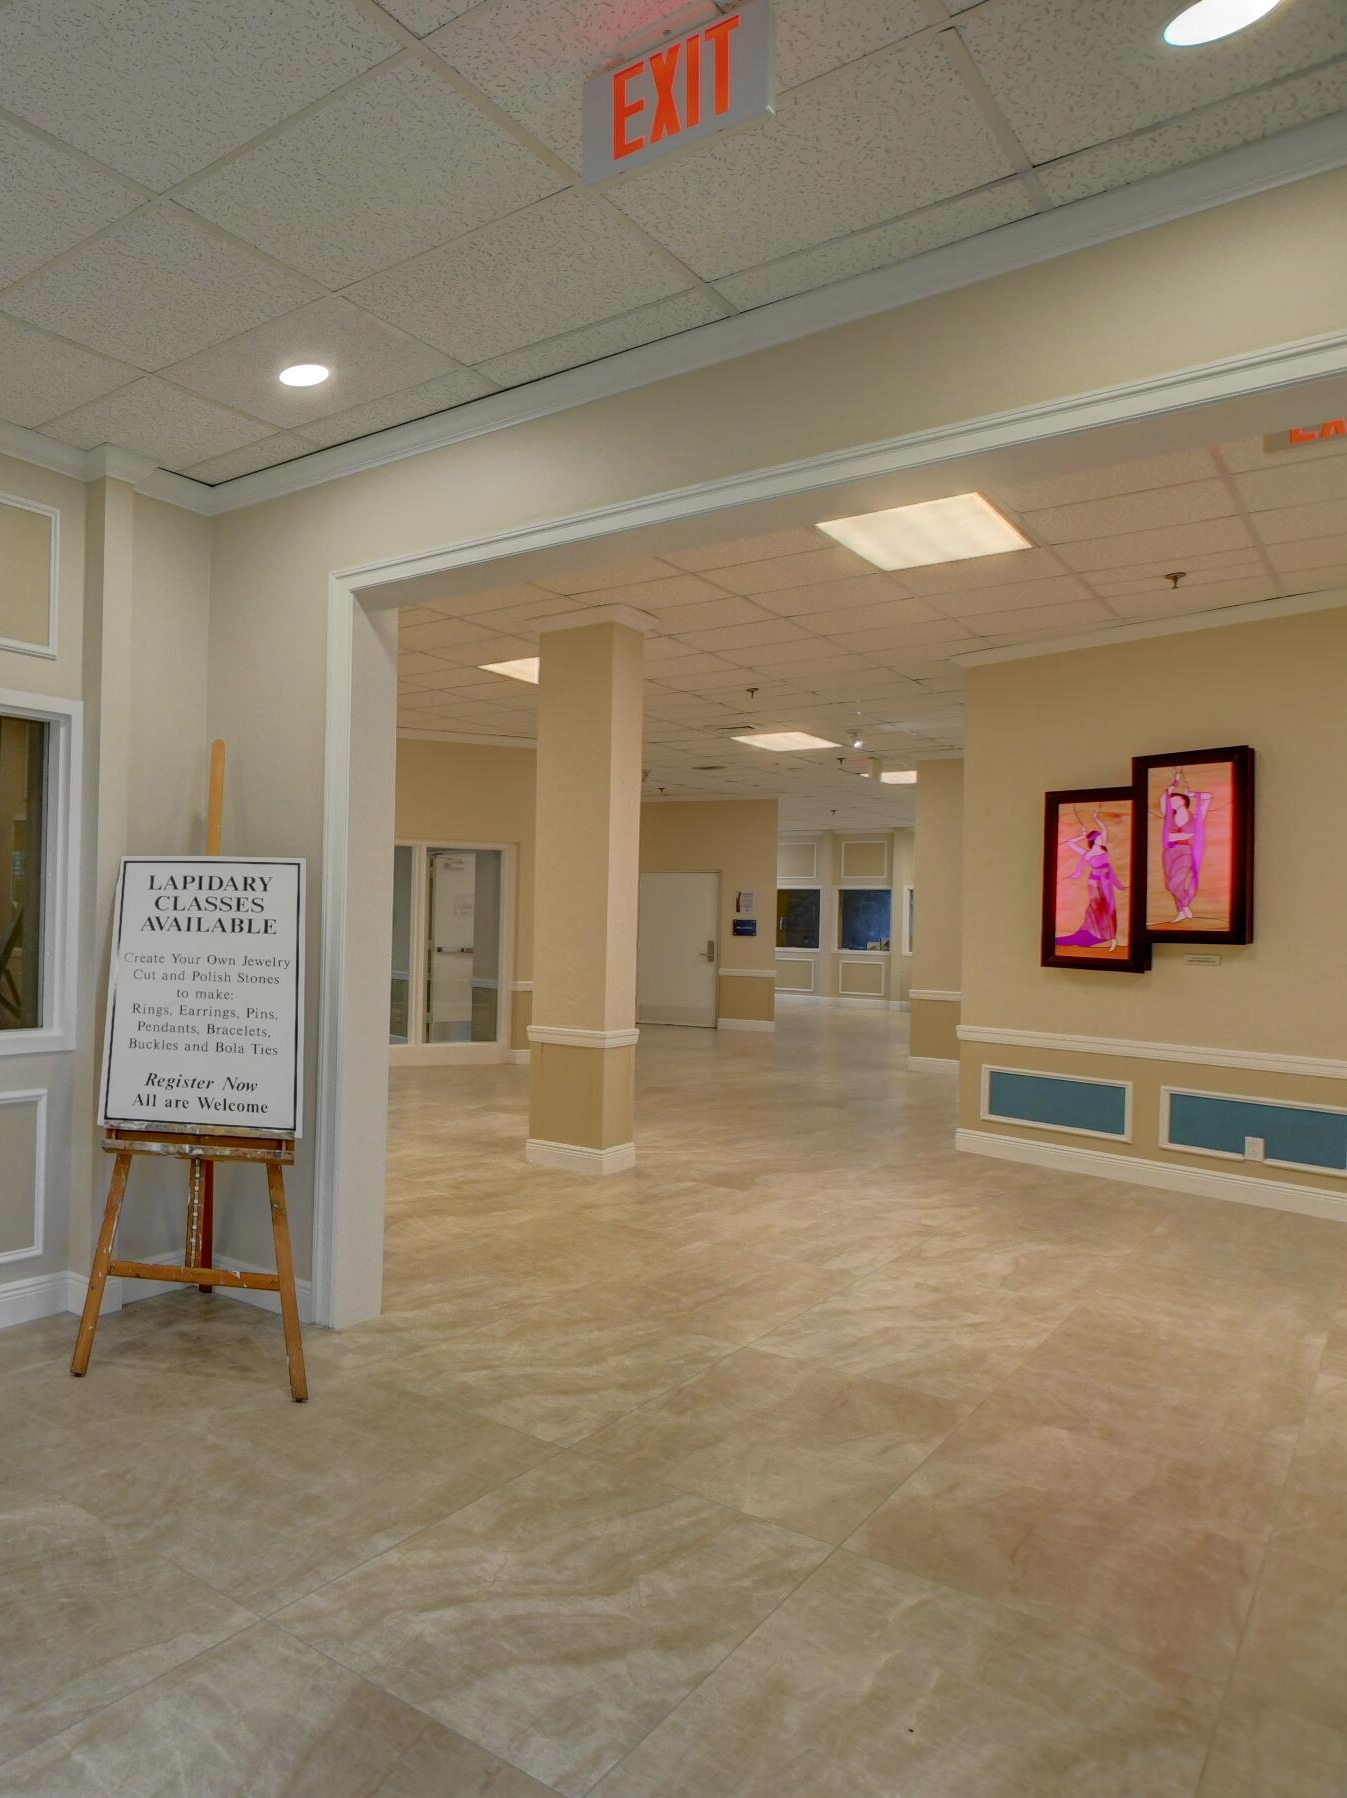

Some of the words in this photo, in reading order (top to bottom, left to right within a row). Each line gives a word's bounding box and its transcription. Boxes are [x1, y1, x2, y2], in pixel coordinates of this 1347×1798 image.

[613, 15, 741, 160] EXIT
[149, 874, 273, 893] LAPIDARY
[154, 895, 264, 913] CLASSES
[141, 916, 277, 935] AVAILABLE
[124, 952, 166, 964] Create
[171, 953, 201, 965] Your
[207, 954, 236, 966] Own
[241, 955, 291, 970] Jewelry
[133, 969, 156, 981] Cut
[162, 970, 185, 982] and
[192, 971, 232, 983] Polish
[237, 973, 280, 985] Stones
[176, 988, 189, 999] to
[195, 988, 234, 1000] make:
[132, 1003, 172, 1018] Rings,
[179, 1005, 240, 1019] Earrings,
[246, 1008, 278, 1021] Pins,
[137, 1021, 200, 1036] Pendants,
[207, 1024, 271, 1039] Bracelets,
[128, 1038, 179, 1052] Buckles
[184, 1041, 209, 1053] and
[215, 1041, 245, 1054] Bola
[250, 1043, 278, 1056] Ties
[144, 1073, 215, 1091] Register
[222, 1076, 259, 1092] Now
[132, 1094, 157, 1108] All
[164, 1098, 190, 1110] are
[196, 1096, 269, 1114] Welcome
